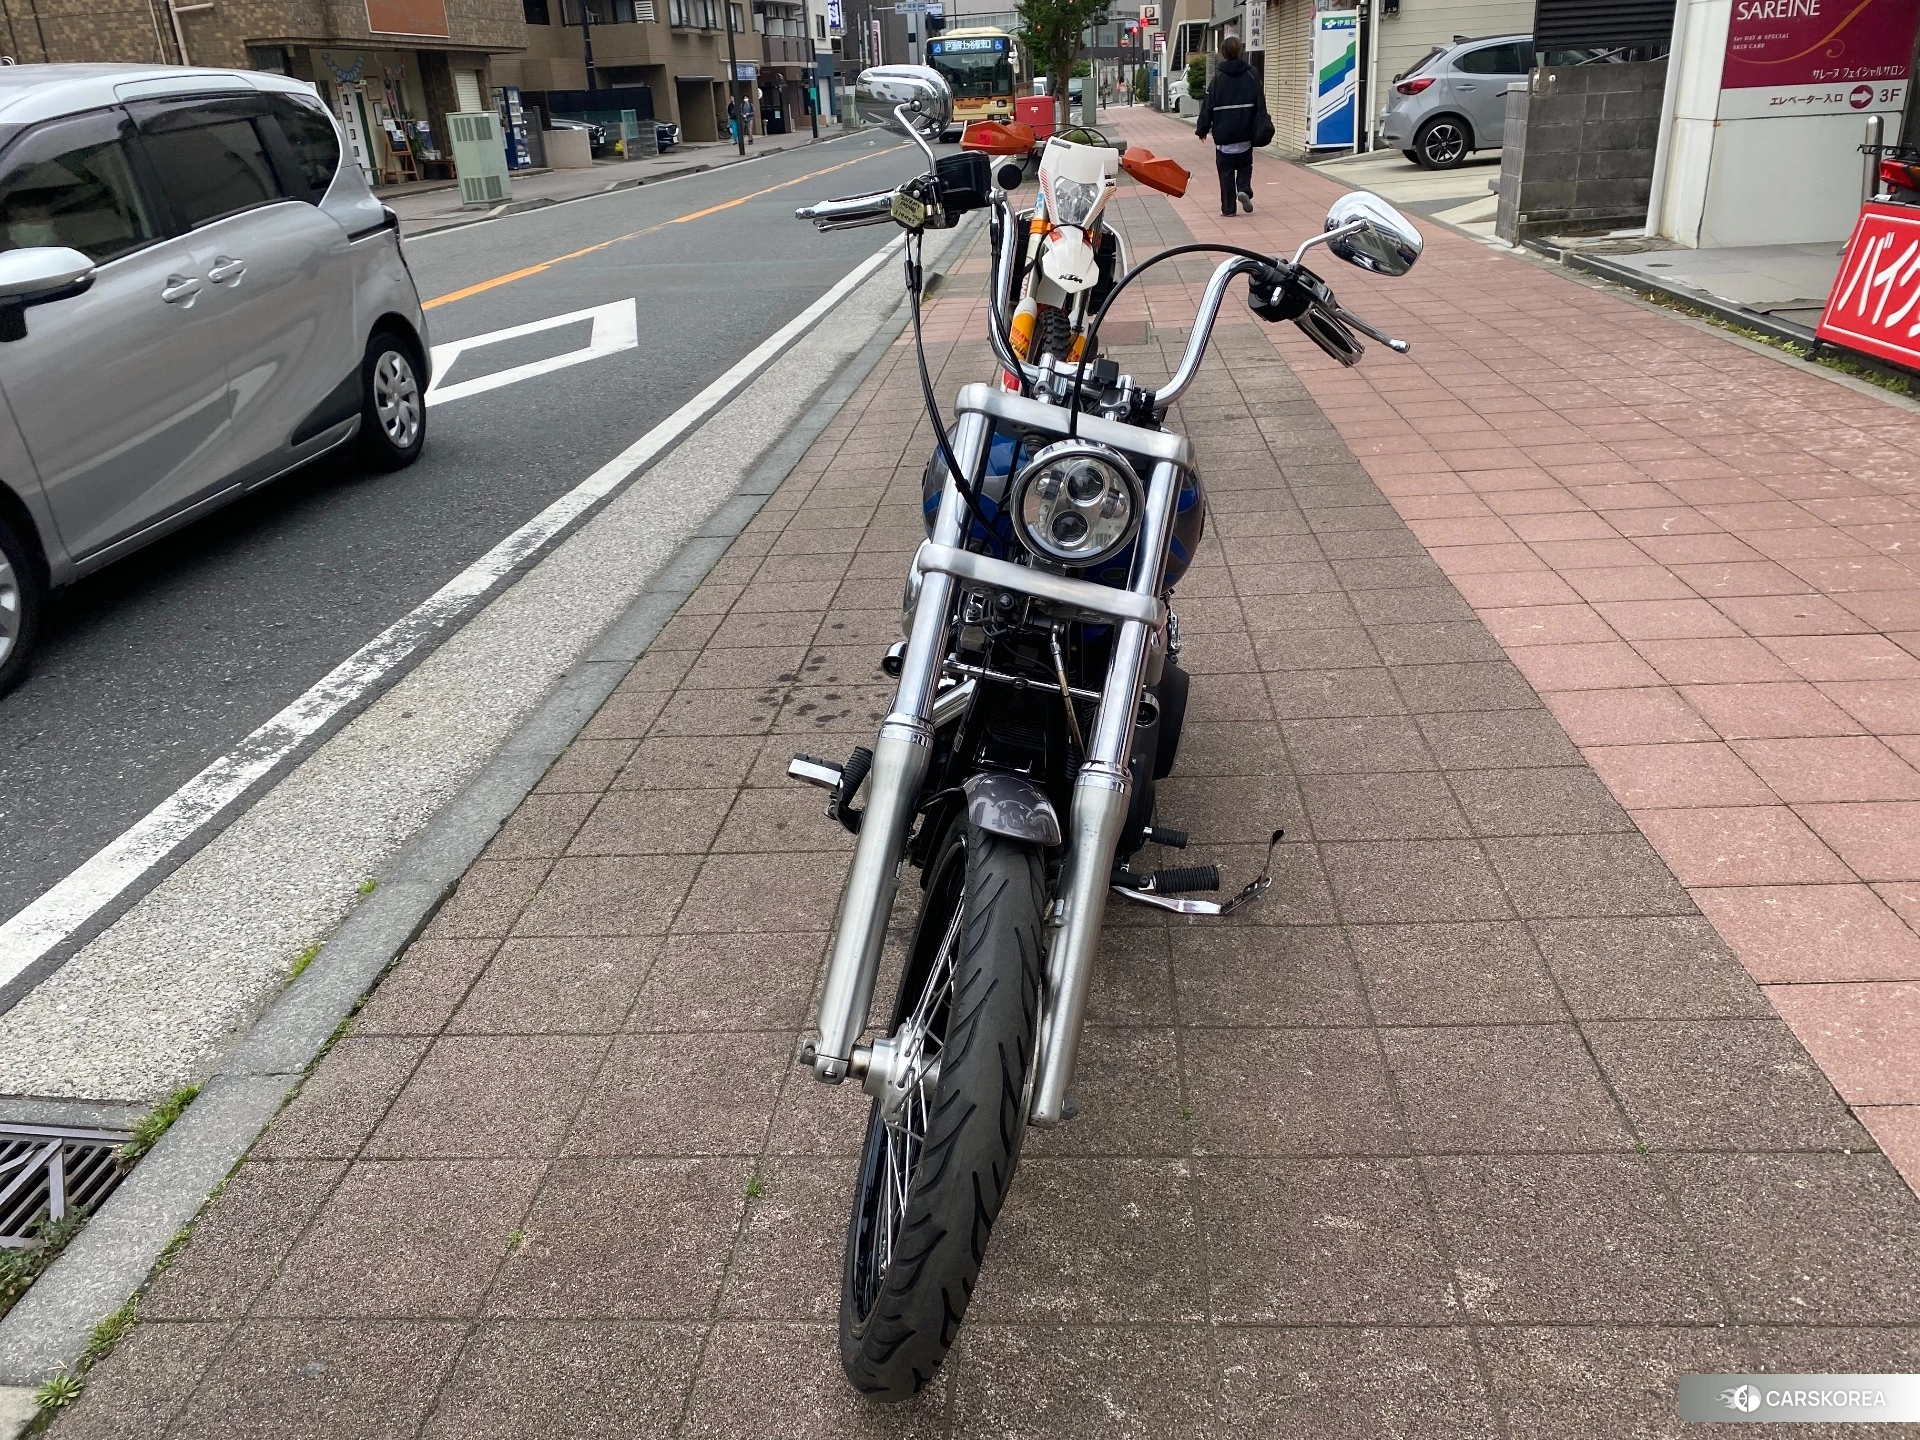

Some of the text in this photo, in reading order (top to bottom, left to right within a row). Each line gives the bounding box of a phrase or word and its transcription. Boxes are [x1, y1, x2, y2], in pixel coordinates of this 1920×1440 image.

[1737, 0, 1821, 20] SAREINE
[1812, 65, 1906, 80] サレーヌ フェイシャルサロン
[1770, 93, 1843, 106] エレベーター入口
[1879, 88, 1902, 103] 3F
[1059, 274, 1083, 284] KTM
[1837, 232, 1920, 338] バイク
